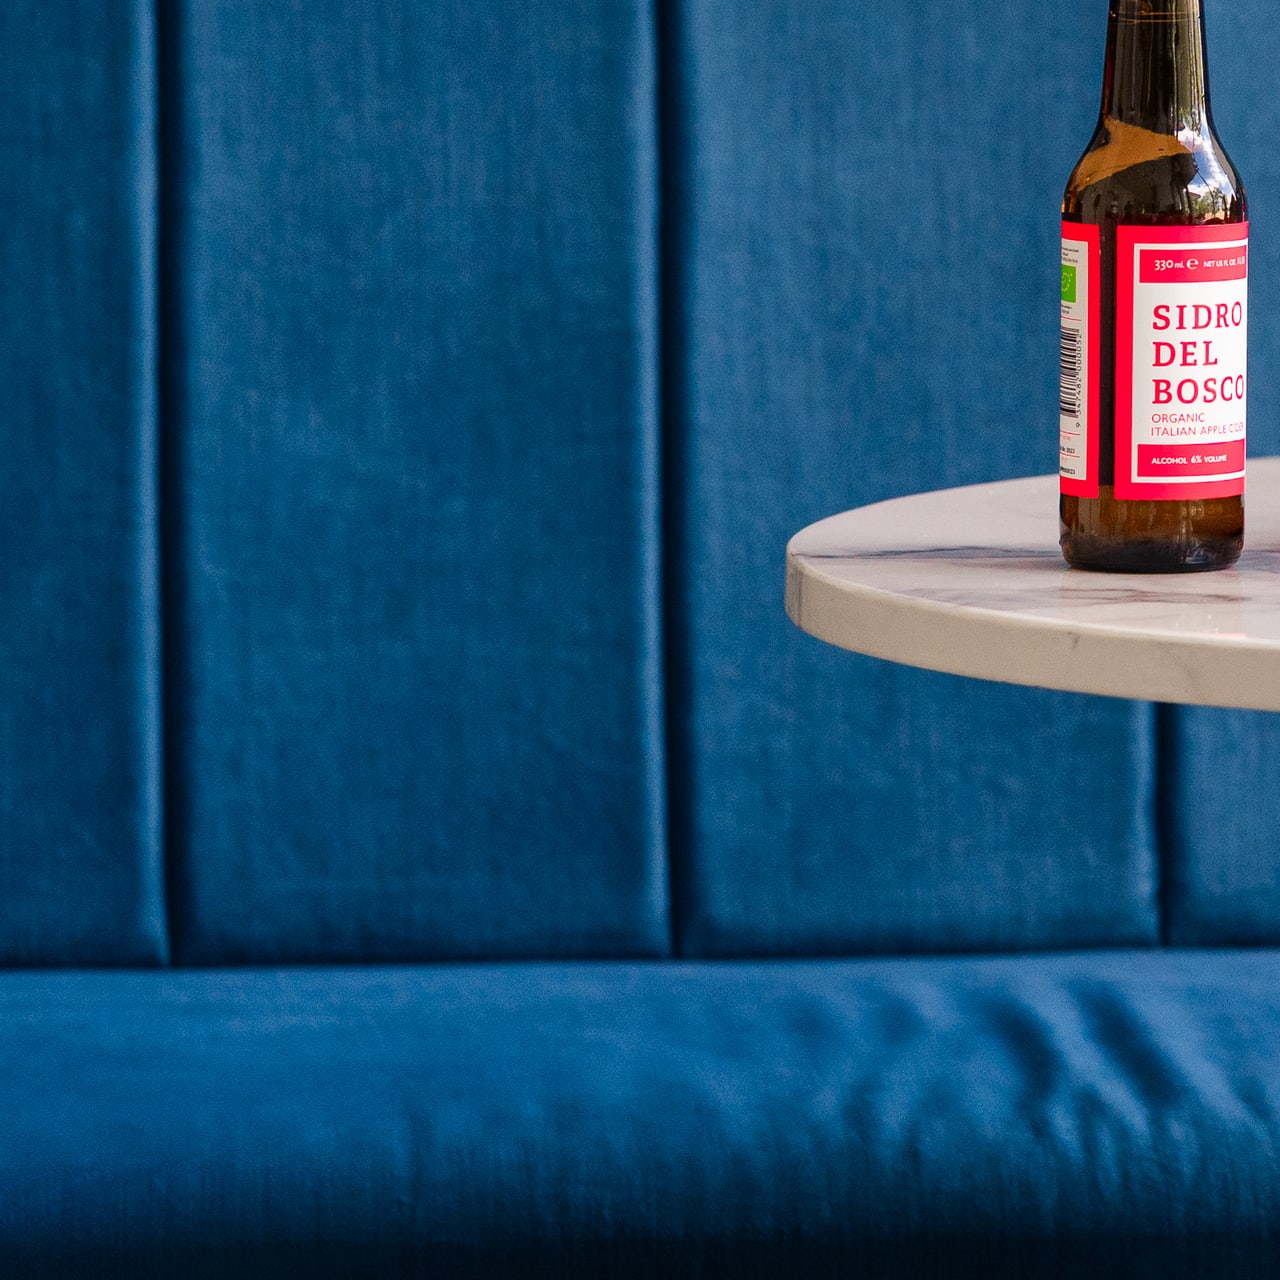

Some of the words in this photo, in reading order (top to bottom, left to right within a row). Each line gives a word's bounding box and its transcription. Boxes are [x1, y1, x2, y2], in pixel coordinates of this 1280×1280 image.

[1153, 301, 1242, 331] SIDRO
[1152, 340, 1218, 367] DEL
[1152, 374, 1244, 404] BOSCO
[1151, 412, 1205, 424] ORGANIC
[1151, 426, 1196, 437] ITALIAN
[1200, 423, 1227, 435] APPLE
[1151, 456, 1188, 465] ALCOHOL
[1190, 455, 1202, 464] 6%
